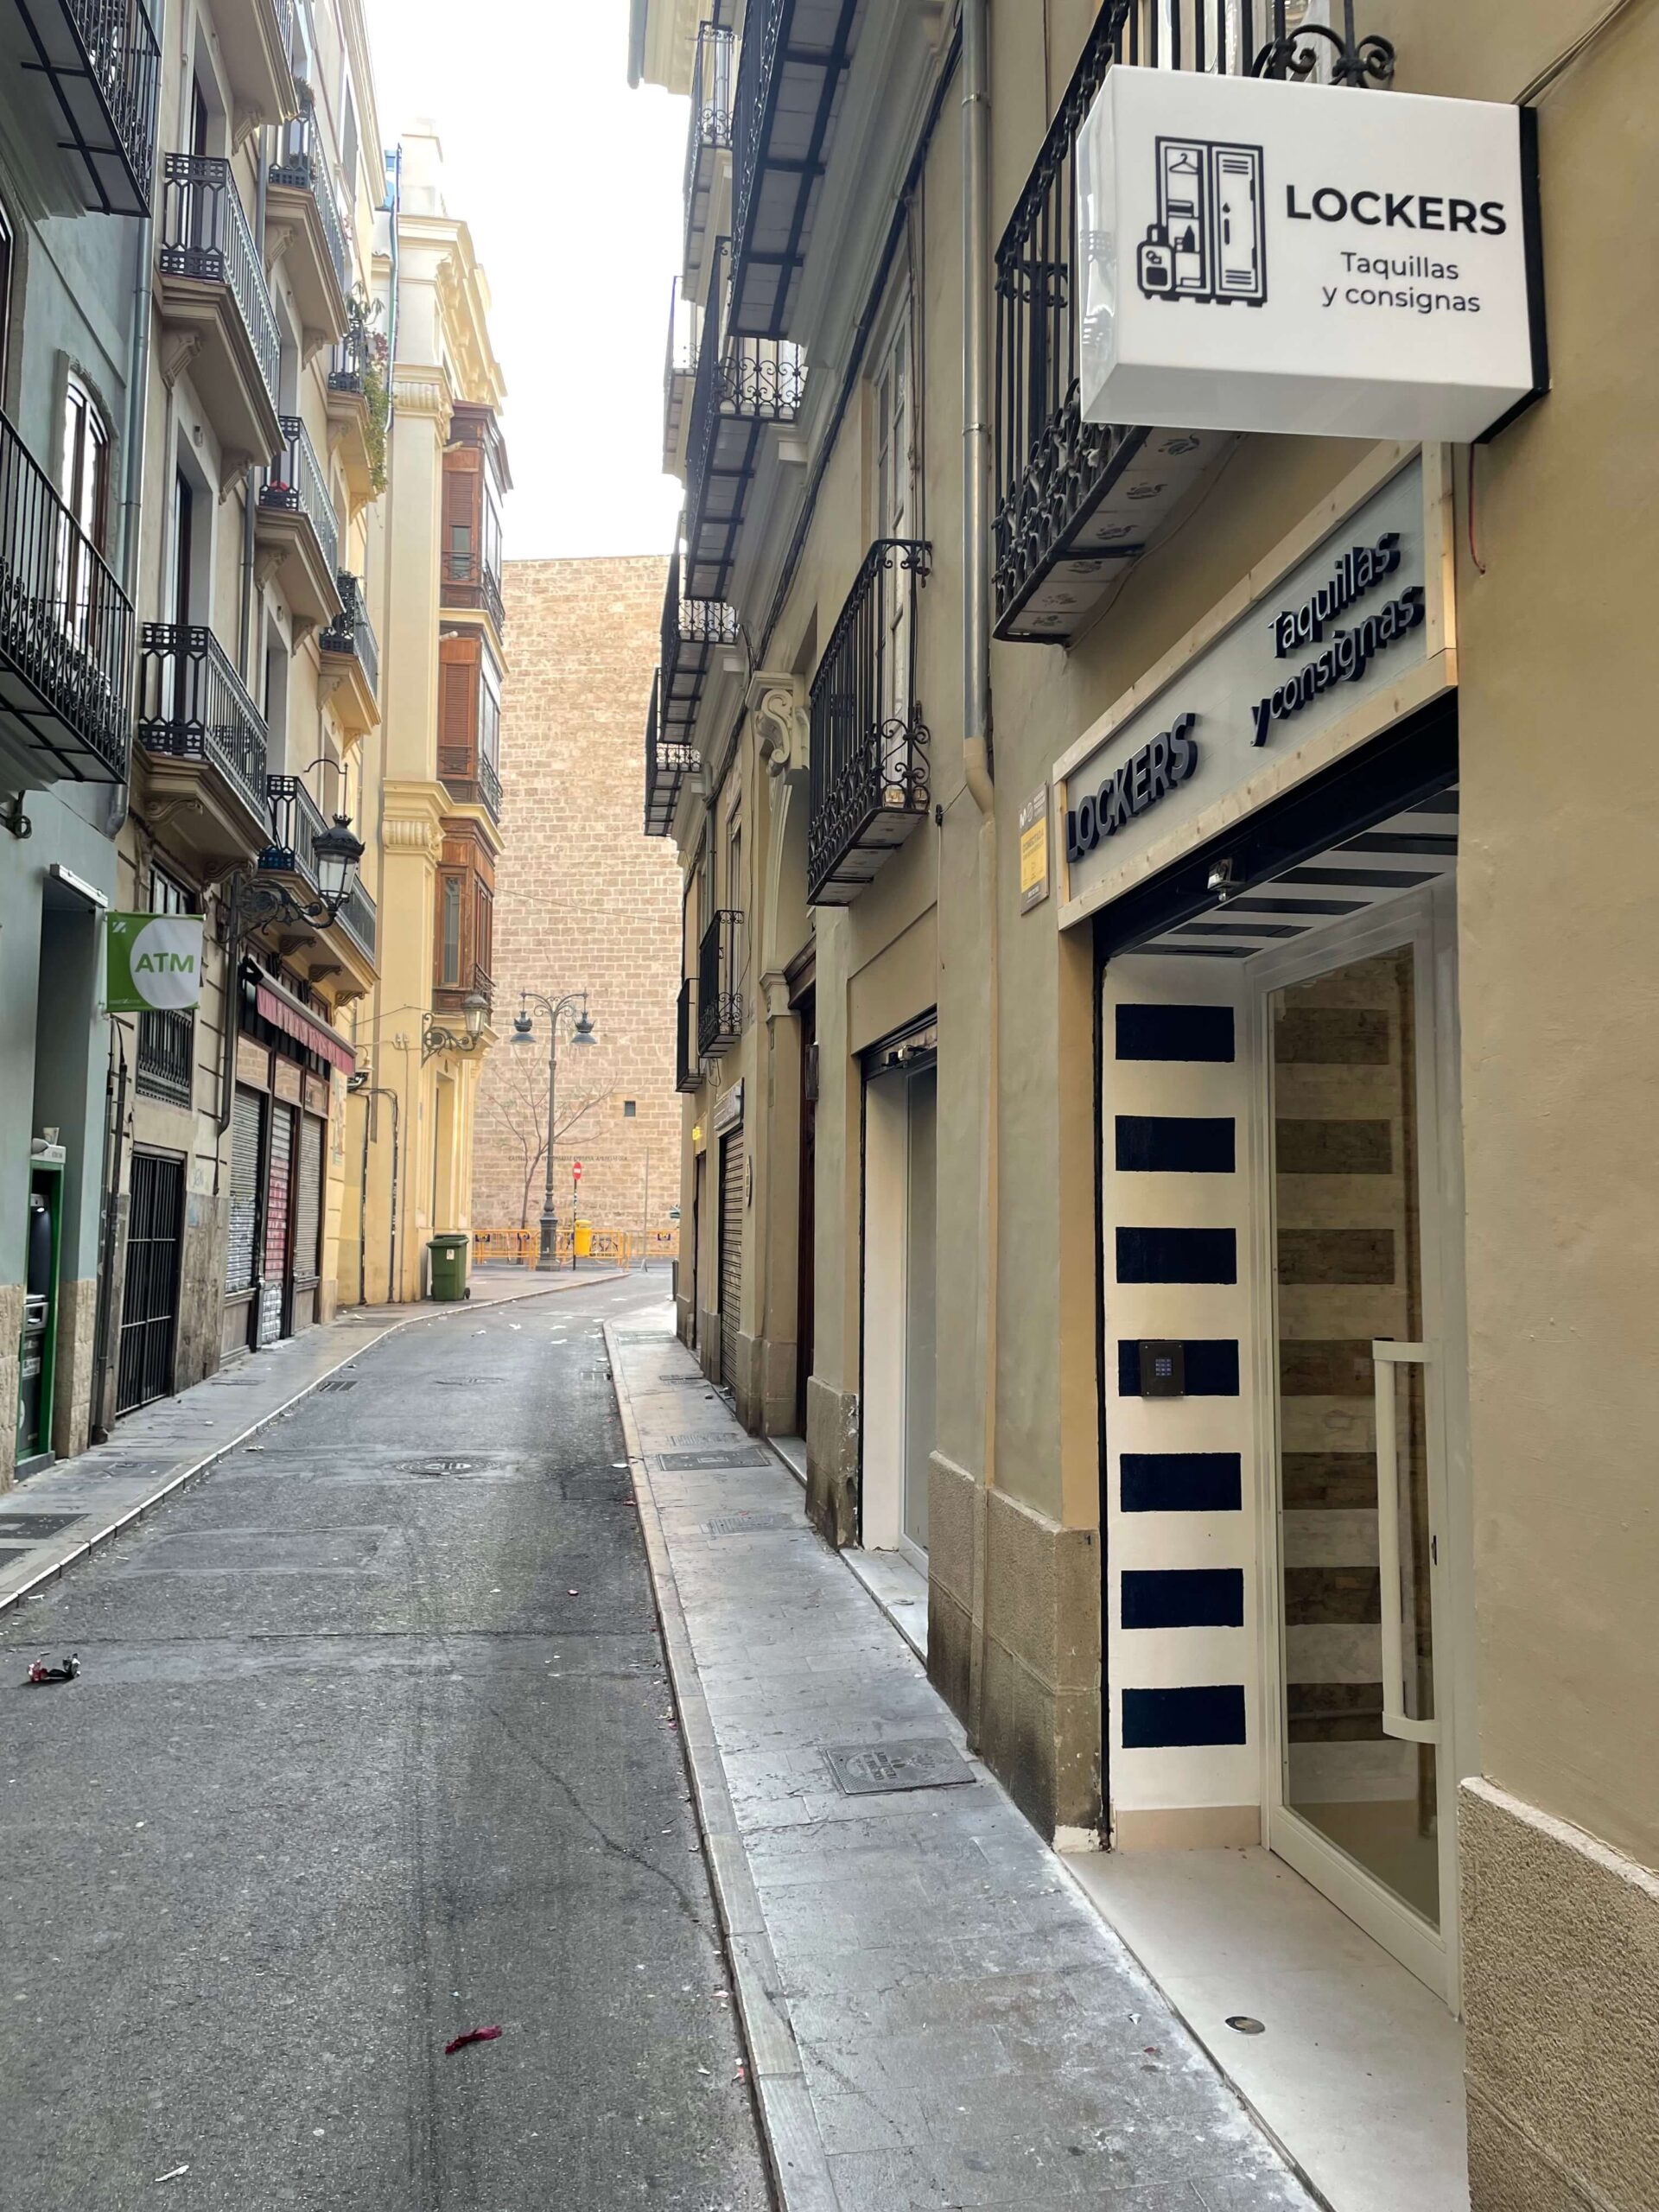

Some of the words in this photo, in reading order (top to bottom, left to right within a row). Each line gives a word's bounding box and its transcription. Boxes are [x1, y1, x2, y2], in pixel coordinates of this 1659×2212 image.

[1286, 184, 1507, 236] LOCKERS
[1340, 251, 1459, 280] Taquillas
[1322, 286, 1338, 308] y
[1345, 288, 1480, 315] consignas
[1268, 532, 1401, 658] Taquillas
[1251, 698, 1270, 747] y
[1270, 586, 1426, 720] consignas
[1065, 712, 1198, 863] LOCKERS
[135, 952, 194, 974] ATM
